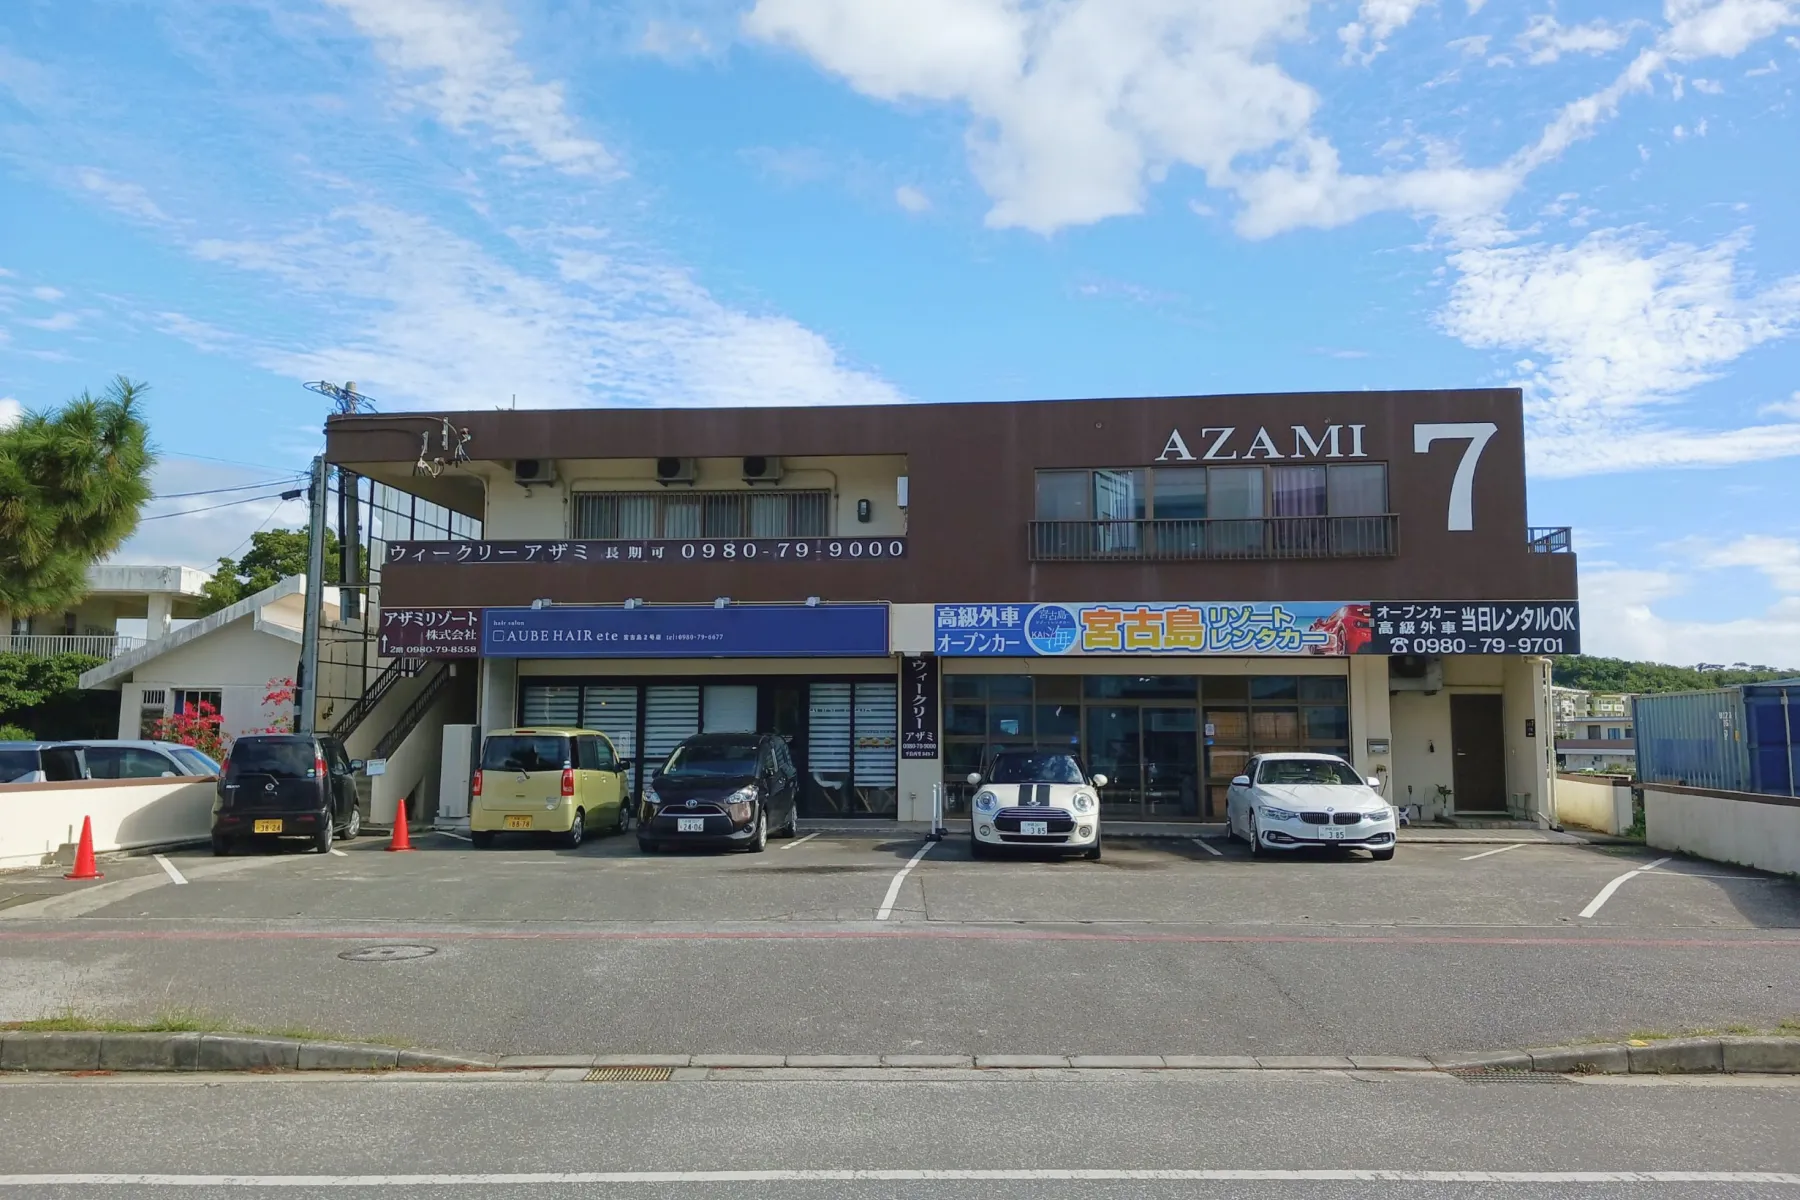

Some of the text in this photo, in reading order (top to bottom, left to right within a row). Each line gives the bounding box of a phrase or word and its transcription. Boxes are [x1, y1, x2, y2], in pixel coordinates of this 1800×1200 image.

[1154, 424, 1368, 460] AZAMI
[1413, 422, 1498, 532] 7
[390, 540, 903, 561] ウィークリーアザミ 長期可 0980-79-9000
[384, 611, 478, 627] アザミリゾート
[937, 606, 1021, 628] 高級外車
[1209, 606, 1293, 630] リゾート
[1377, 605, 1456, 619] オープンカー
[1461, 606, 1576, 632] 当日レンタルOK
[425, 629, 477, 641] 株式会社
[506, 630, 549, 642] AUBE
[552, 629, 592, 641] HAIR
[596, 632, 618, 641] ete
[1081, 607, 1204, 650] 宮古島
[1210, 627, 1327, 649] レンタカー
[1377, 621, 1456, 635] 高級外車
[406, 645, 477, 653] 0980-79-8558
[937, 632, 1020, 653] オープンカー
[1413, 638, 1563, 653] 0980-79-9701
[912, 660, 928, 729] ウィークリー
[905, 731, 934, 742] アザミ
